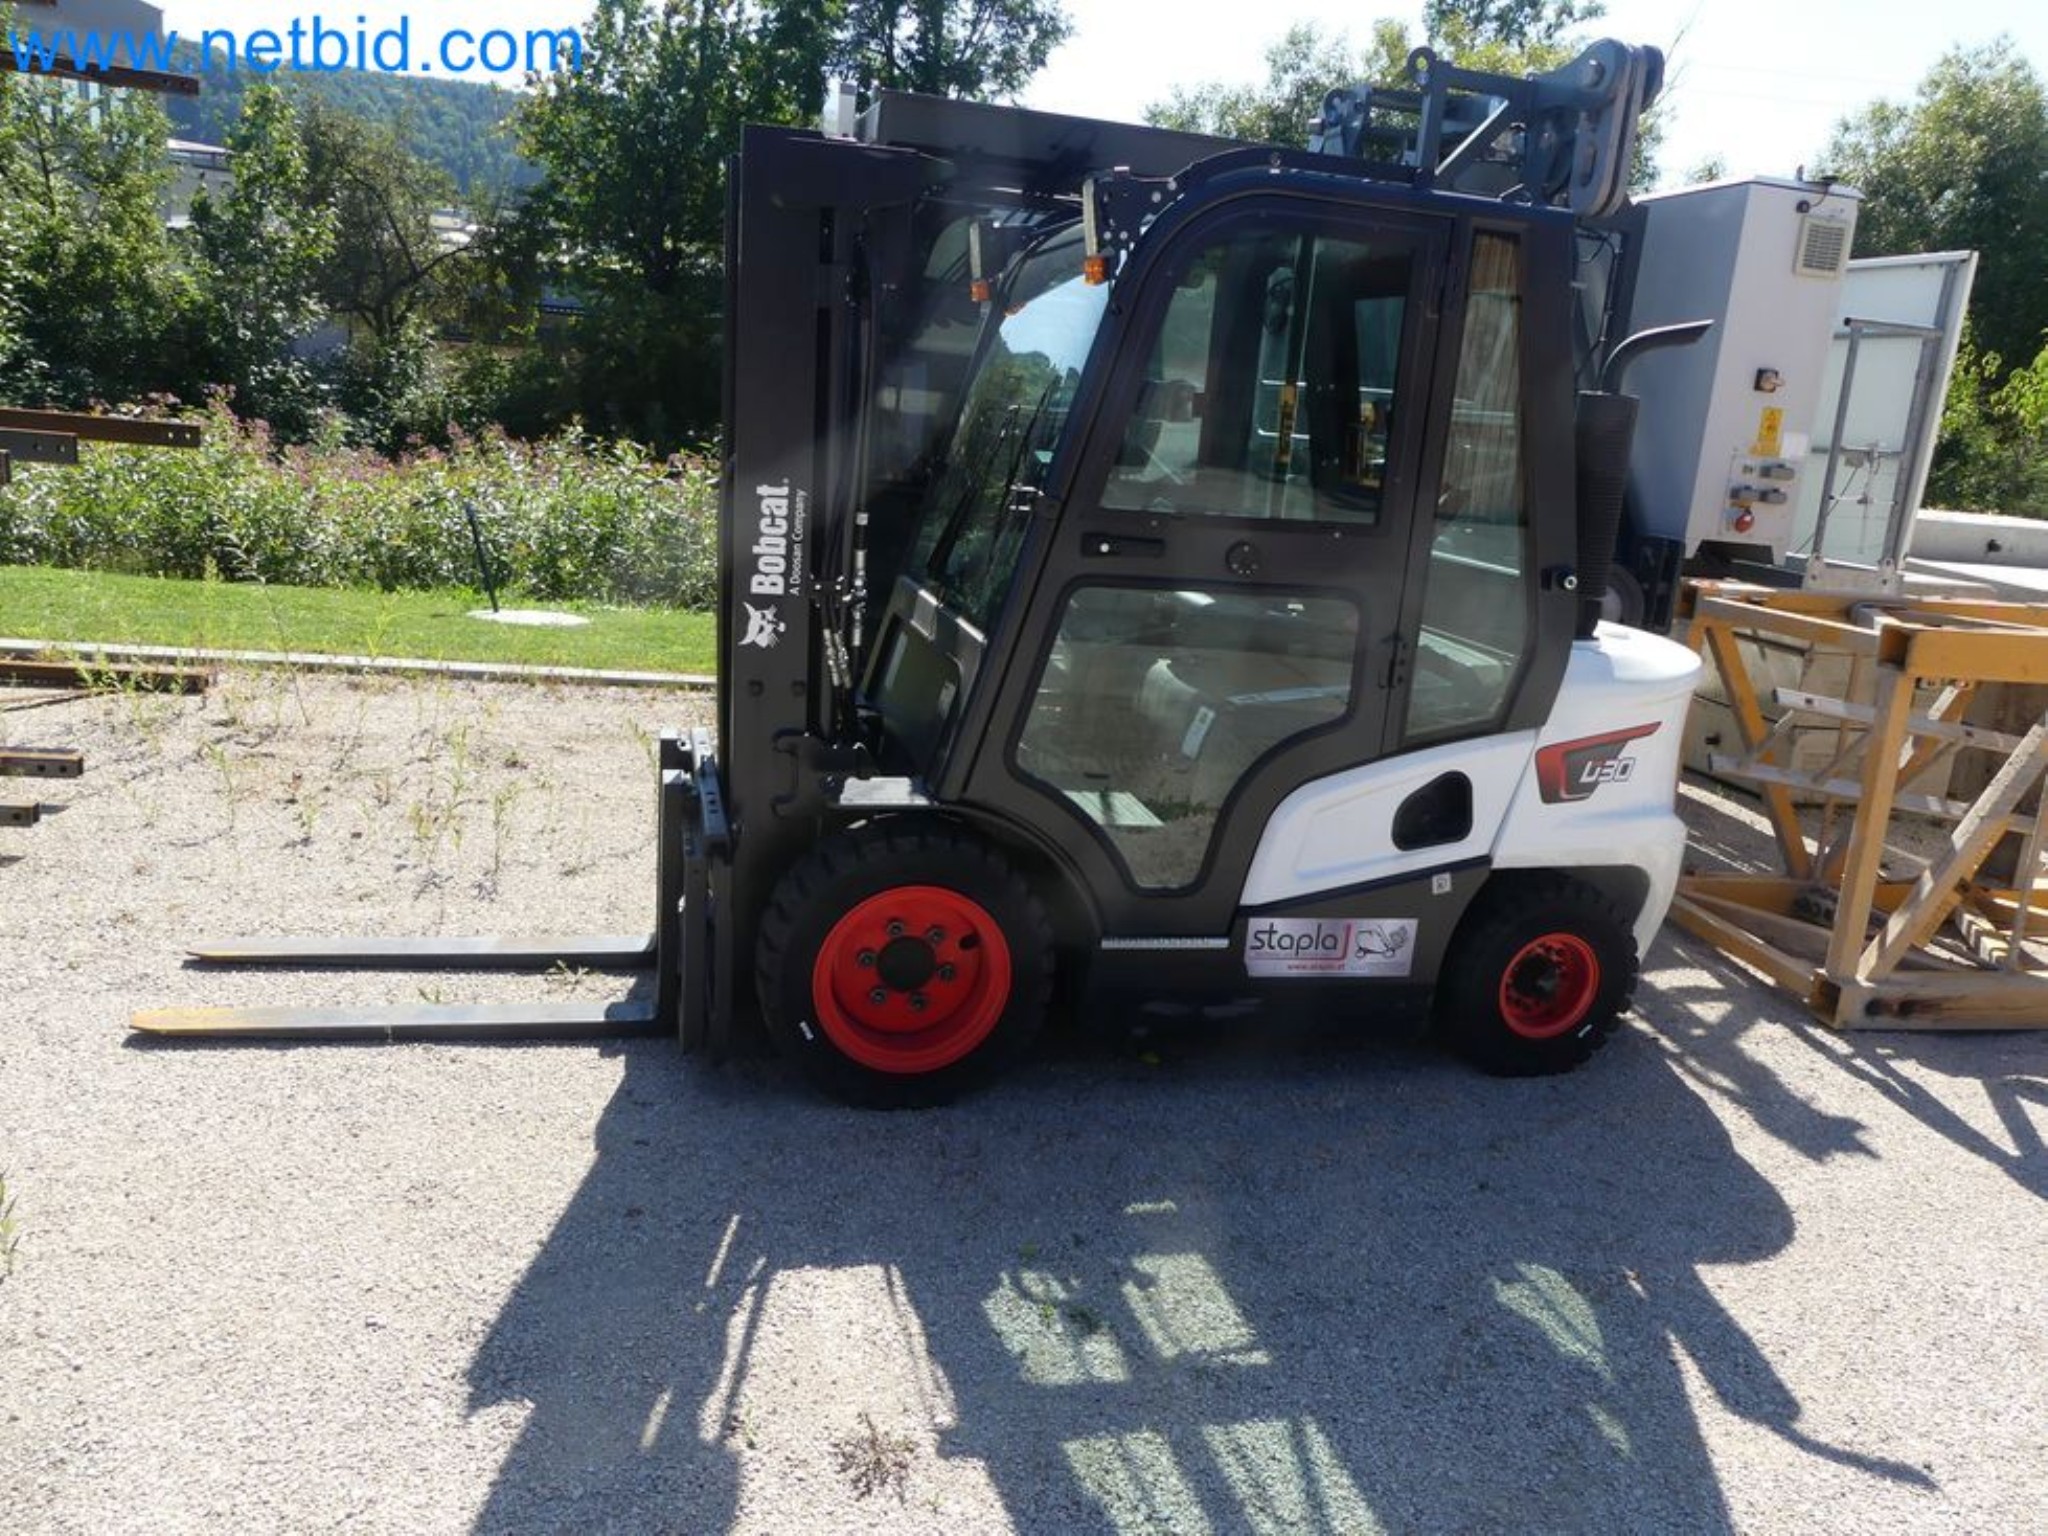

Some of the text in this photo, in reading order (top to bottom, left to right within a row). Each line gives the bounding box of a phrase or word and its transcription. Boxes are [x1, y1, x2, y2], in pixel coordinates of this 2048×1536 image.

[750, 484, 789, 595] Bobcat
[792, 488, 808, 541] Company
[789, 587, 800, 596] A
